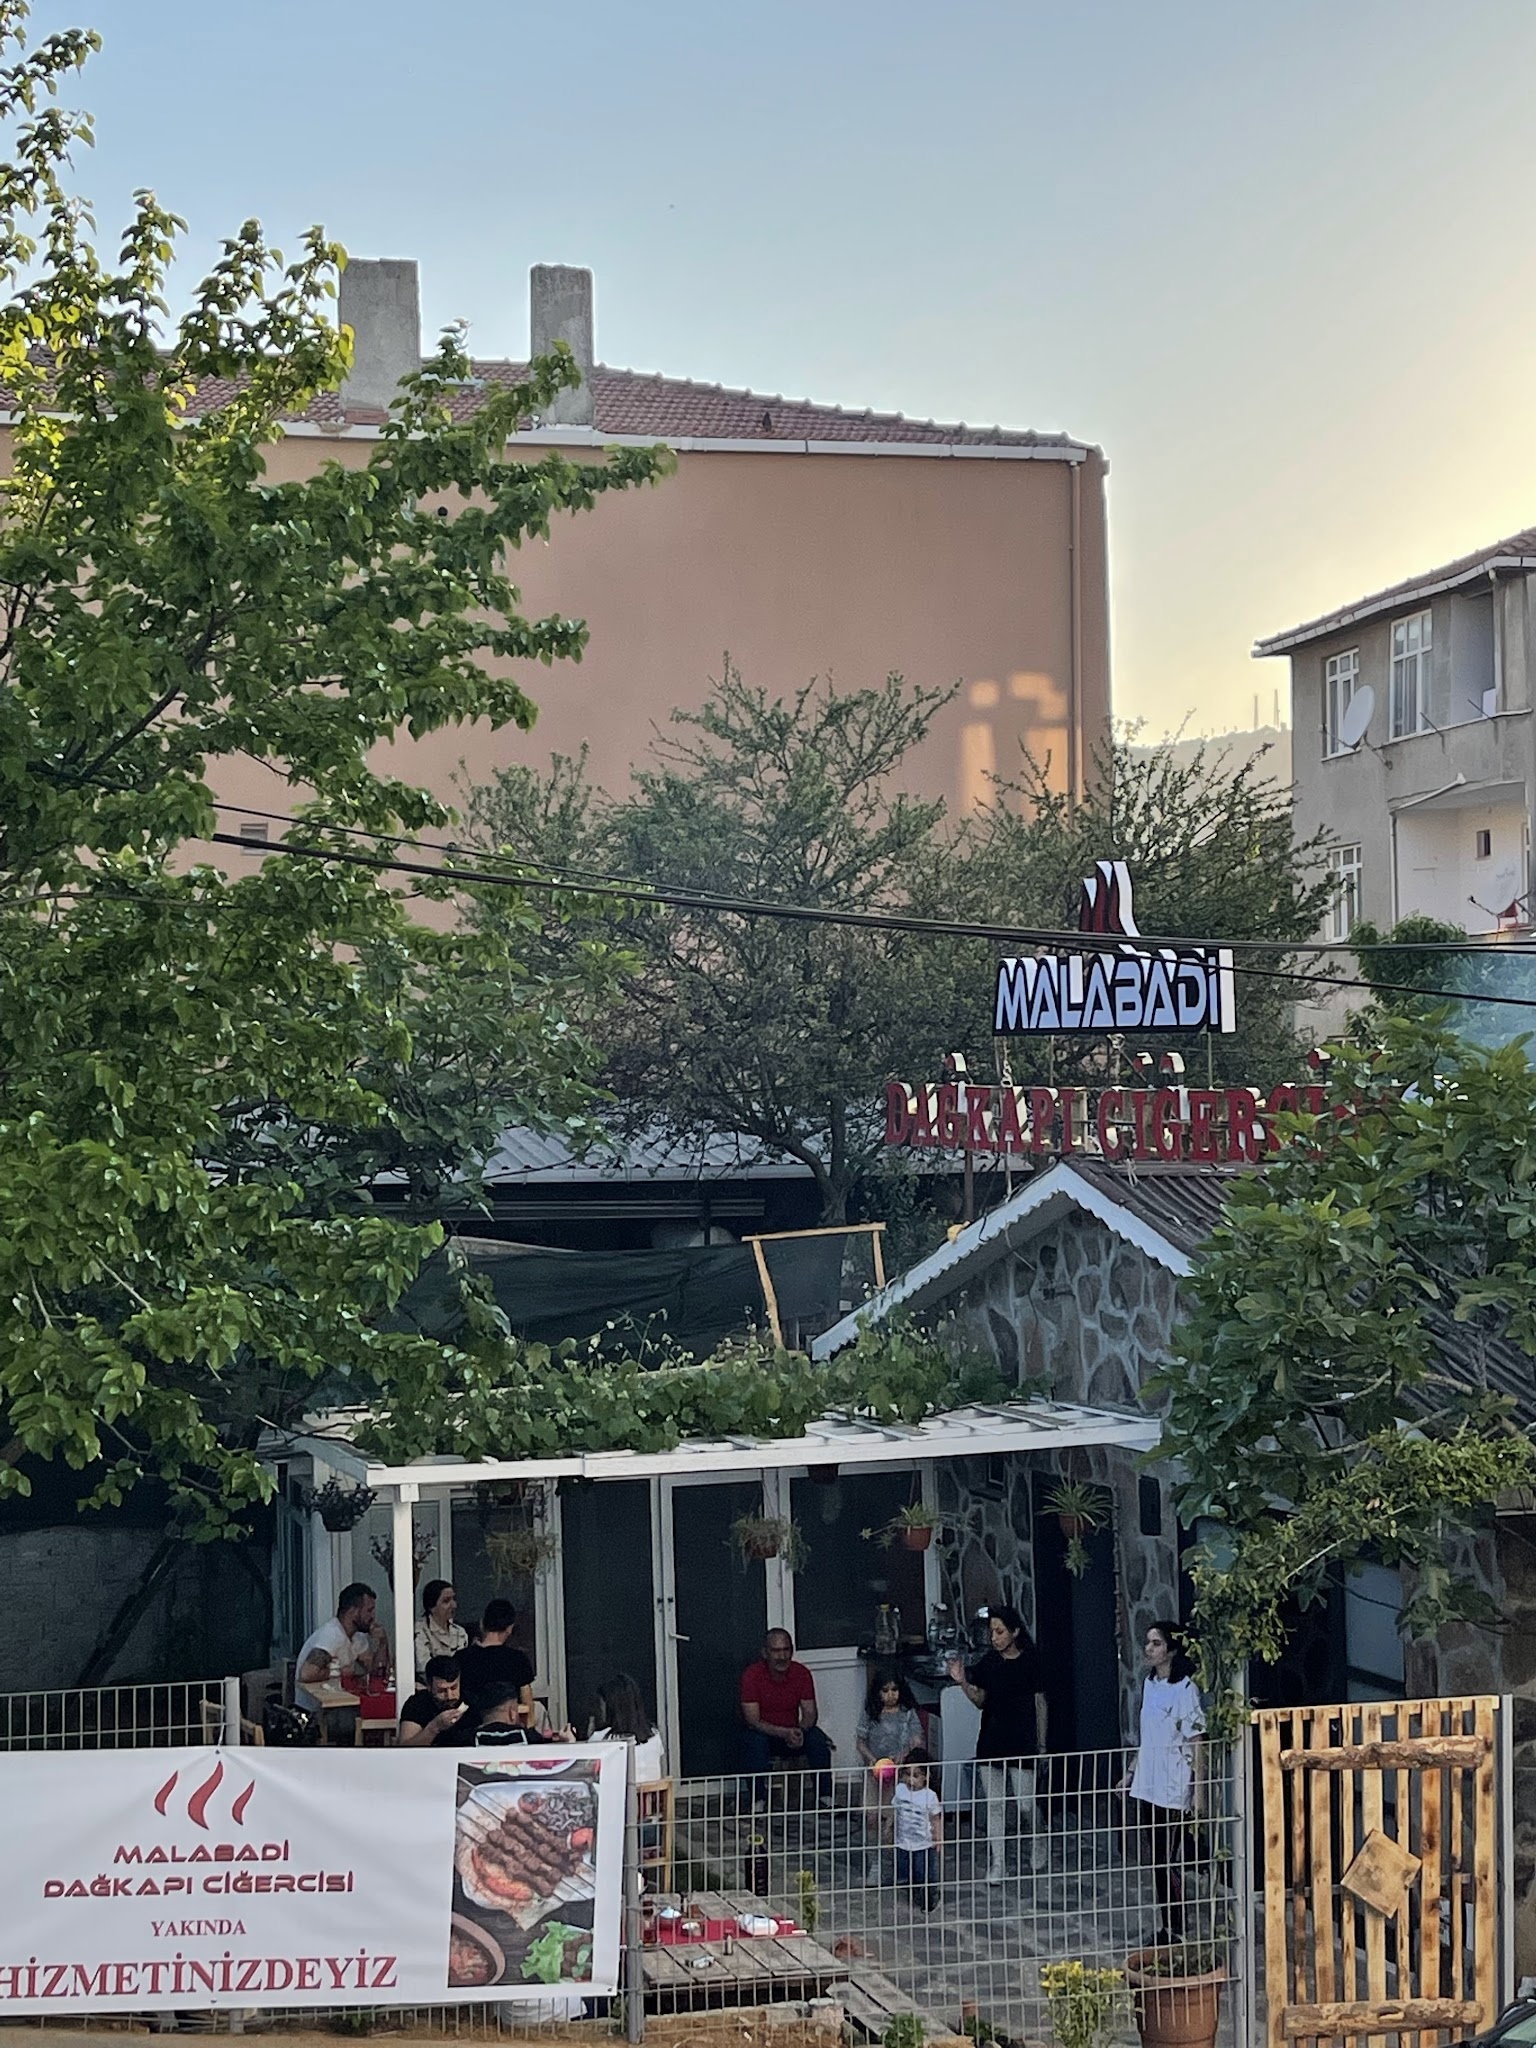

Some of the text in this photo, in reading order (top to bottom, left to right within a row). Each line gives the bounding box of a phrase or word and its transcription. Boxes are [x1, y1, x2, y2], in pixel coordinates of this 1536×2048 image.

[994, 948, 1236, 1033] MALABADİ
[113, 1839, 289, 1864] MALABADİ
[43, 1870, 353, 1898] DAĞKAPI CİĞERCİSİ
[151, 1919, 247, 1937] YAKINDA
[0, 1948, 398, 1998] HİZMETİNİZDEYİZ
